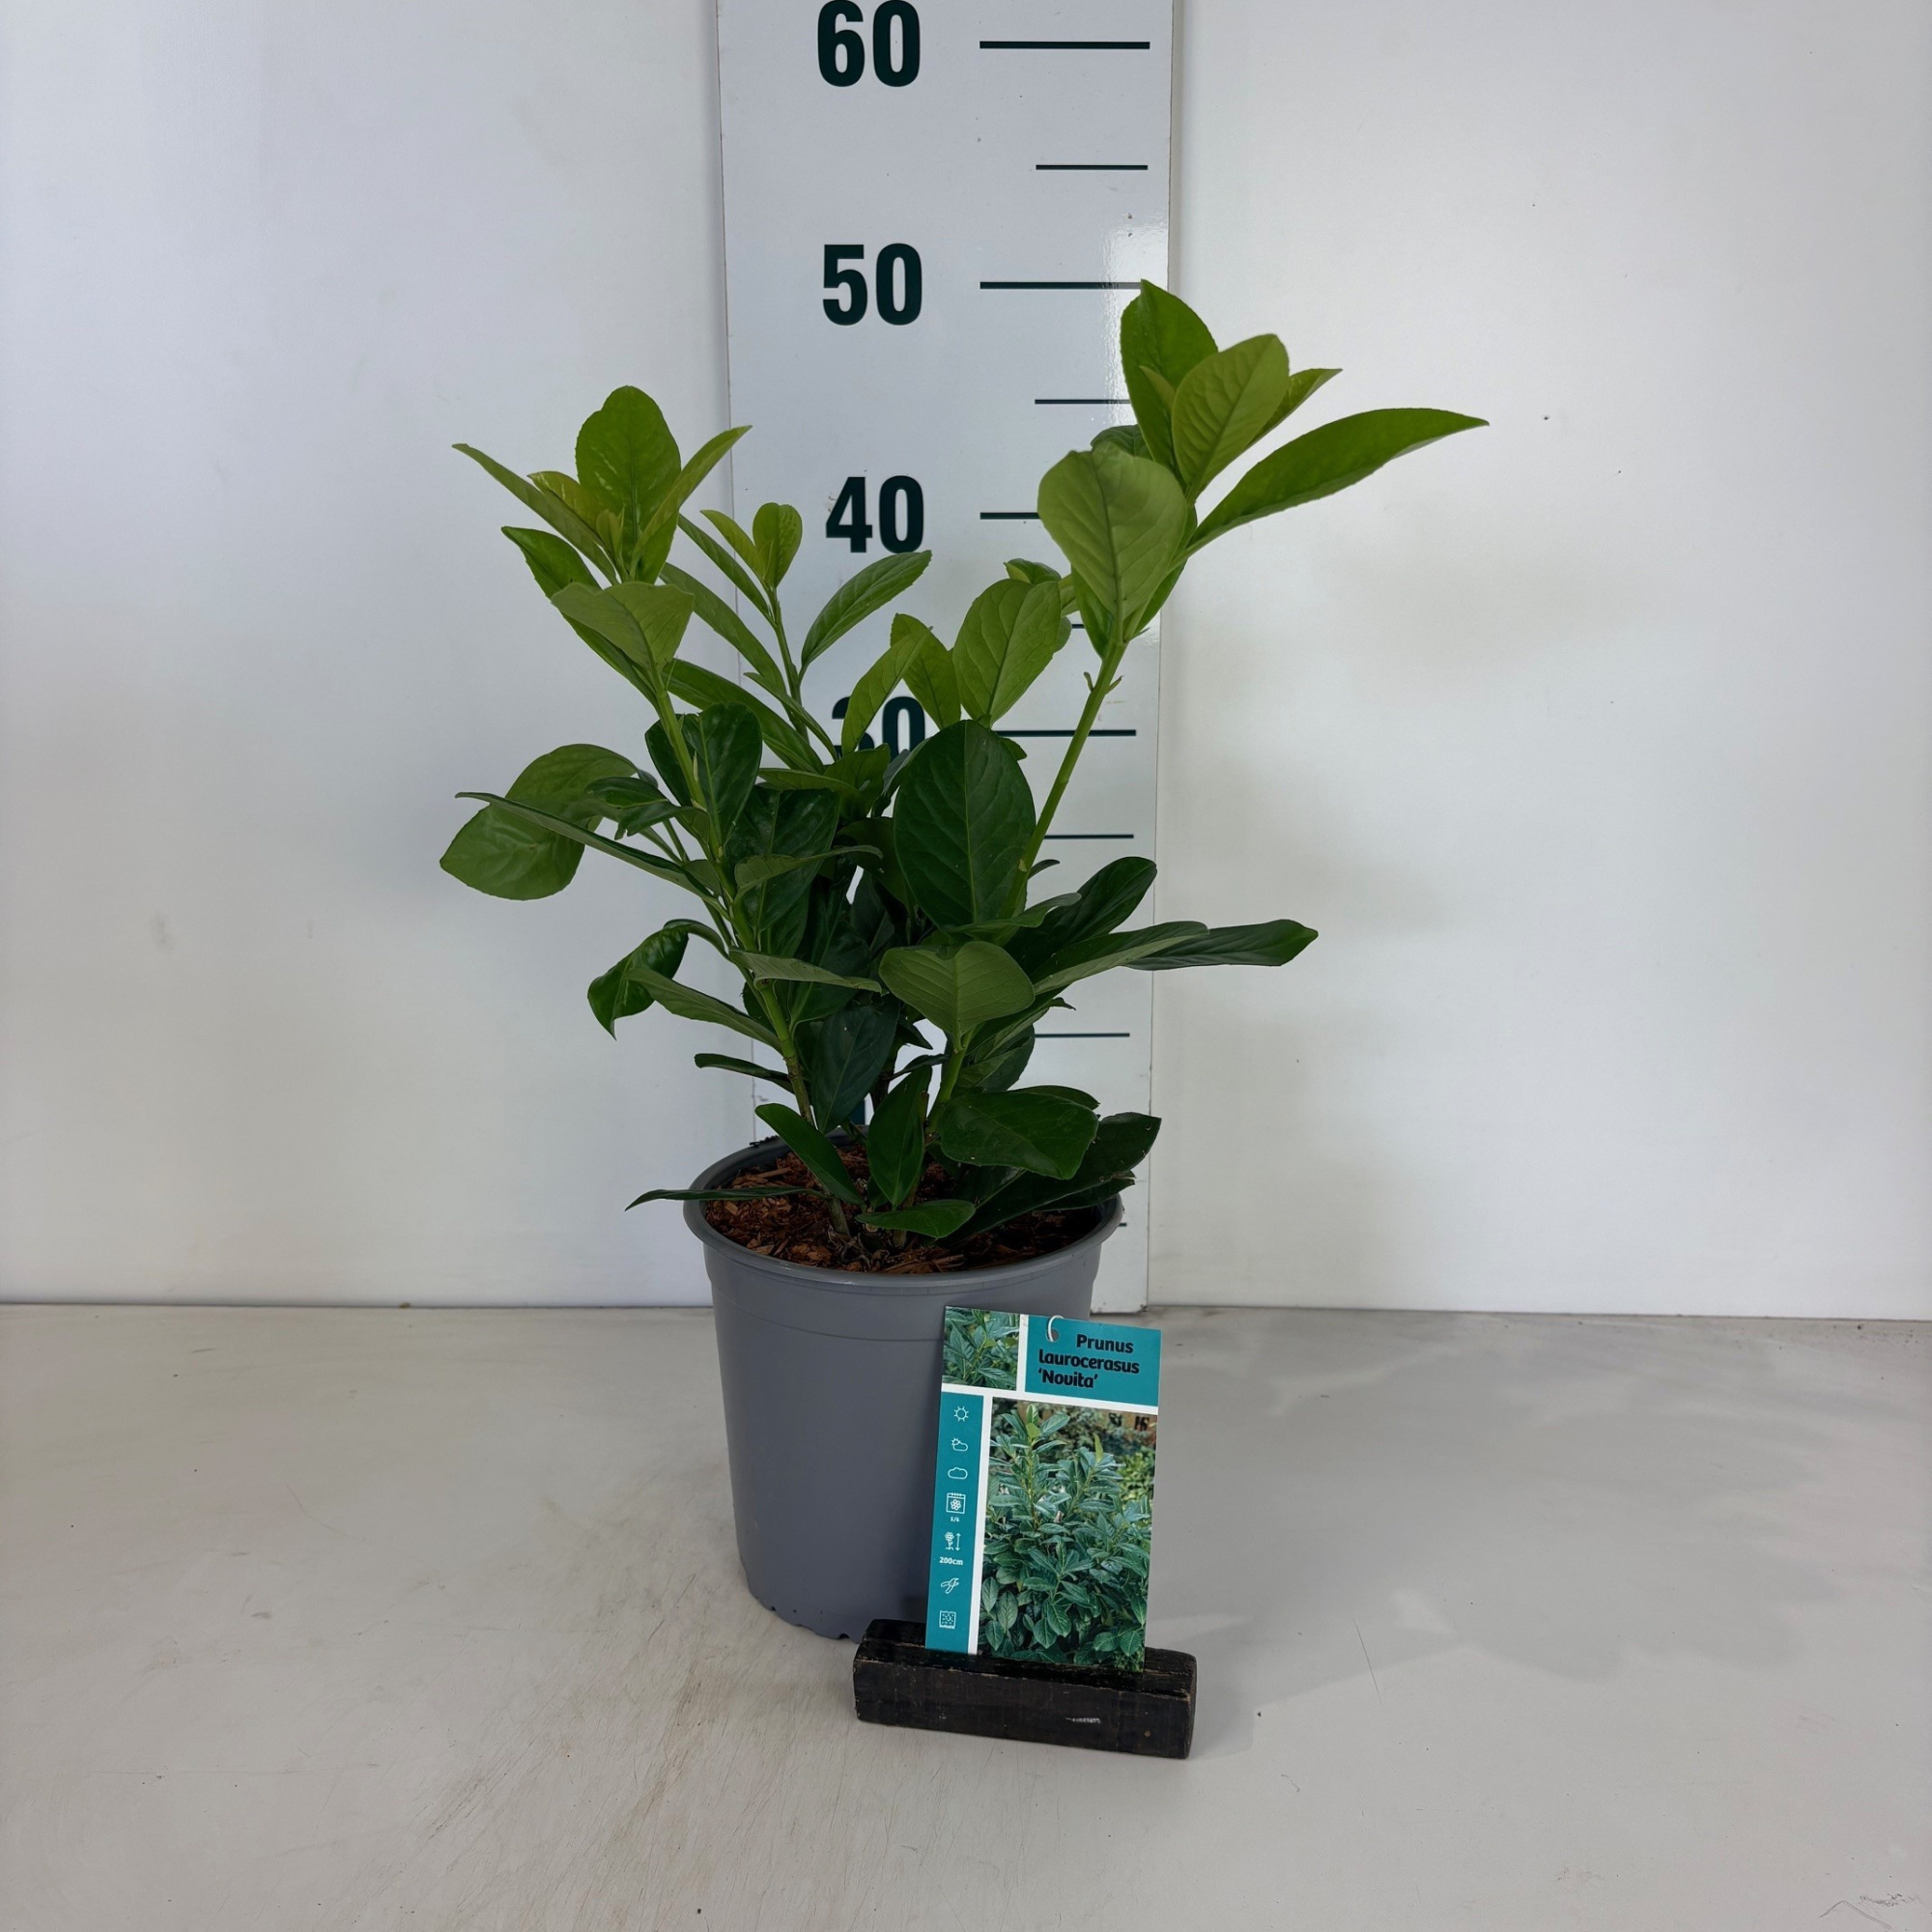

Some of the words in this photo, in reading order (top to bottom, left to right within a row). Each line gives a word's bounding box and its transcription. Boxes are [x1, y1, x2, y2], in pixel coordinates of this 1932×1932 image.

[817, 0, 921, 87] 60
[822, 242, 923, 326] 50
[825, 475, 924, 554] 40
[1076, 1333, 1134, 1354] Prunus
[939, 1556, 964, 1566] 200cm
